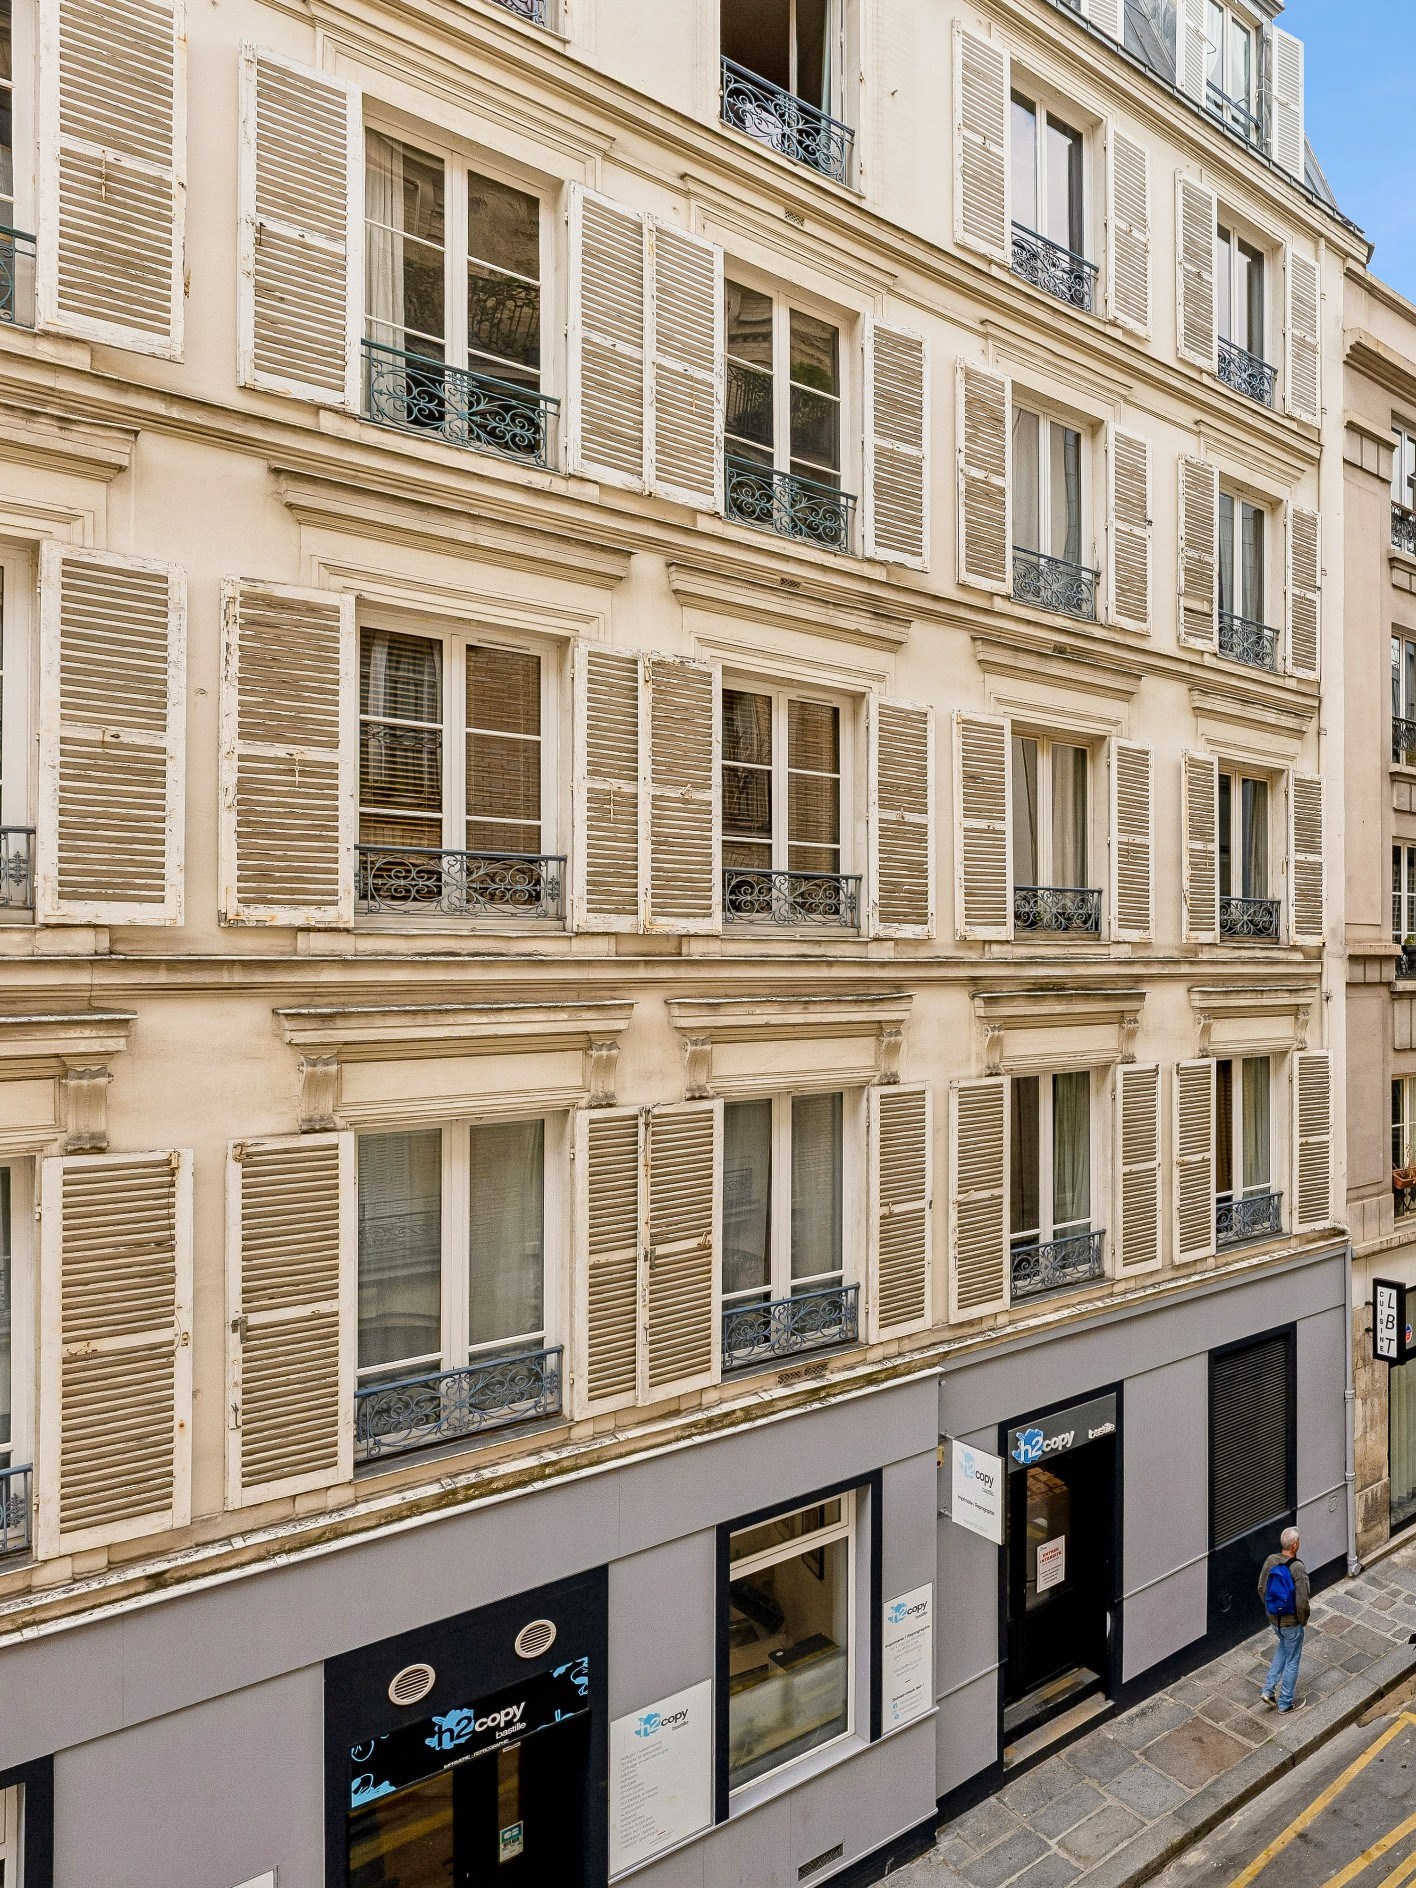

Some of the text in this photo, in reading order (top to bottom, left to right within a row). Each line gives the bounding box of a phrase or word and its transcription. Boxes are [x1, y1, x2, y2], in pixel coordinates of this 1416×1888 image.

[1385, 1292, 1396, 1354] LBT
[1020, 1422, 1116, 1463] h2copy bastille
[437, 1701, 526, 1750] h2copy
[495, 1722, 527, 1739] bastille
